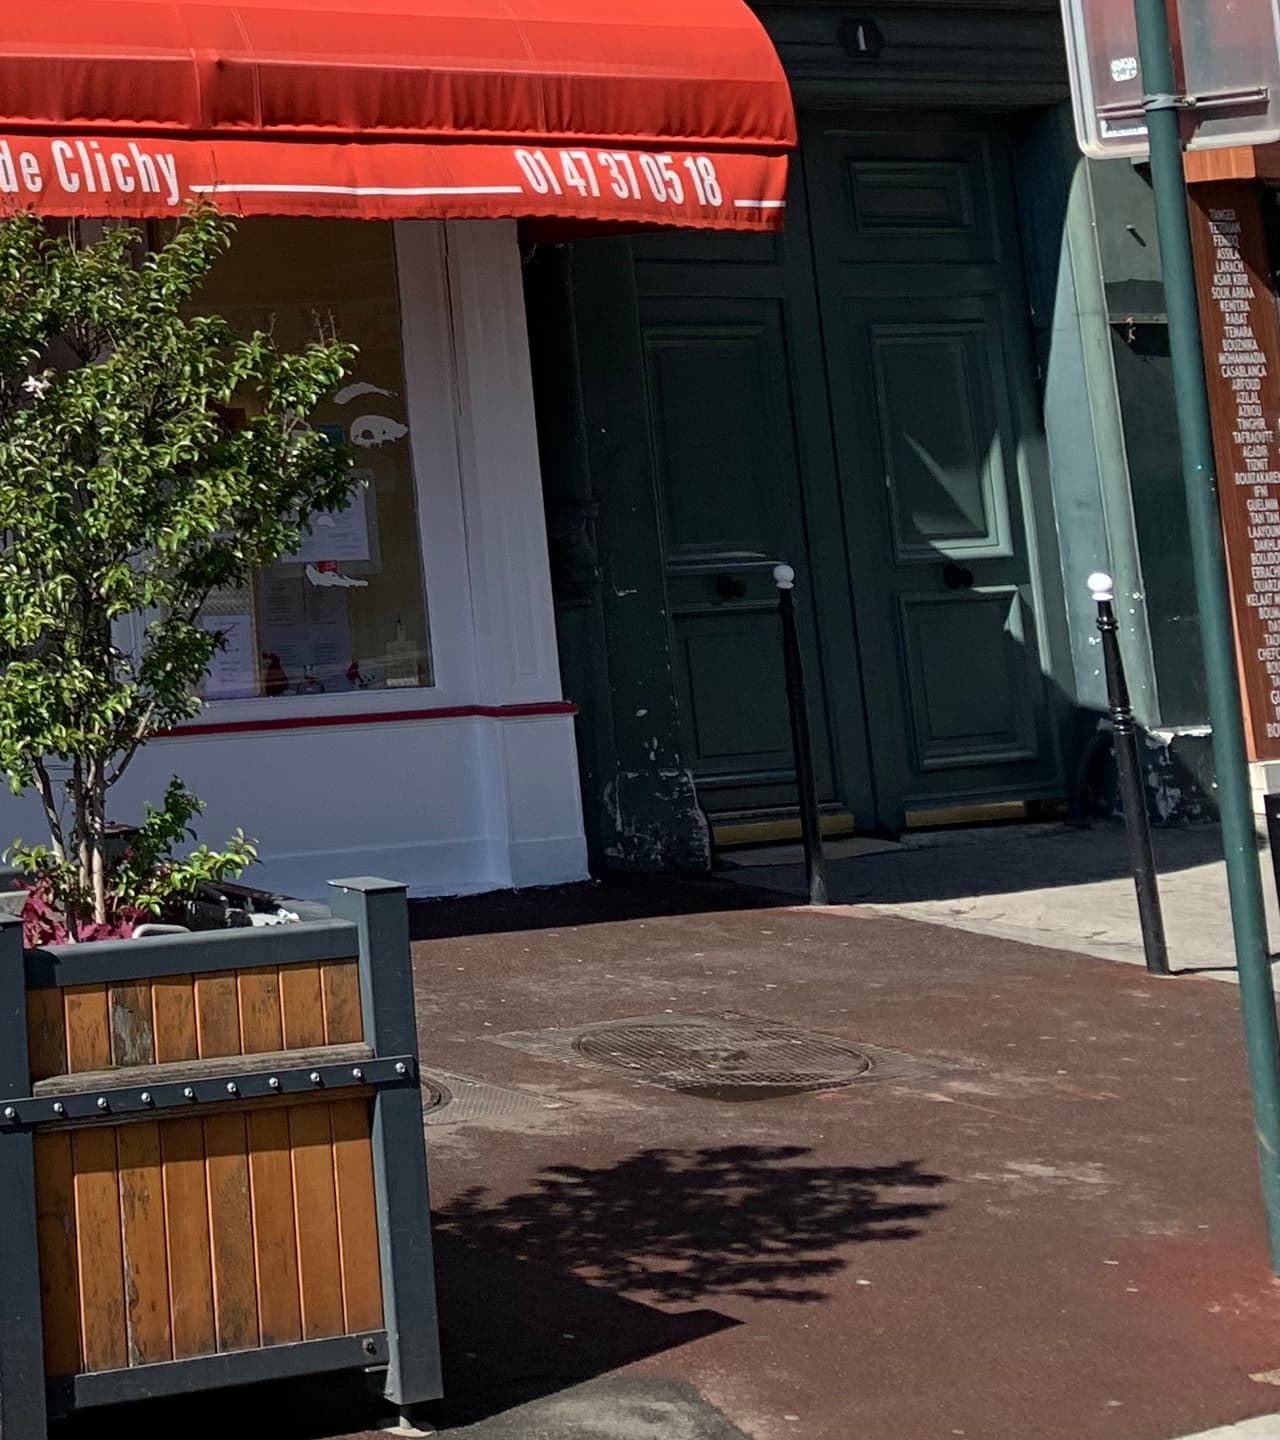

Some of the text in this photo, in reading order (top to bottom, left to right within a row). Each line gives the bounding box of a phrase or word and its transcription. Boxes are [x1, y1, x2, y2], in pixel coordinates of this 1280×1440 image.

[51, 140, 181, 206] Clichy
[514, 148, 723, 207] 01 47 37 05 18
[1221, 365, 1267, 377] CASABLANCA
